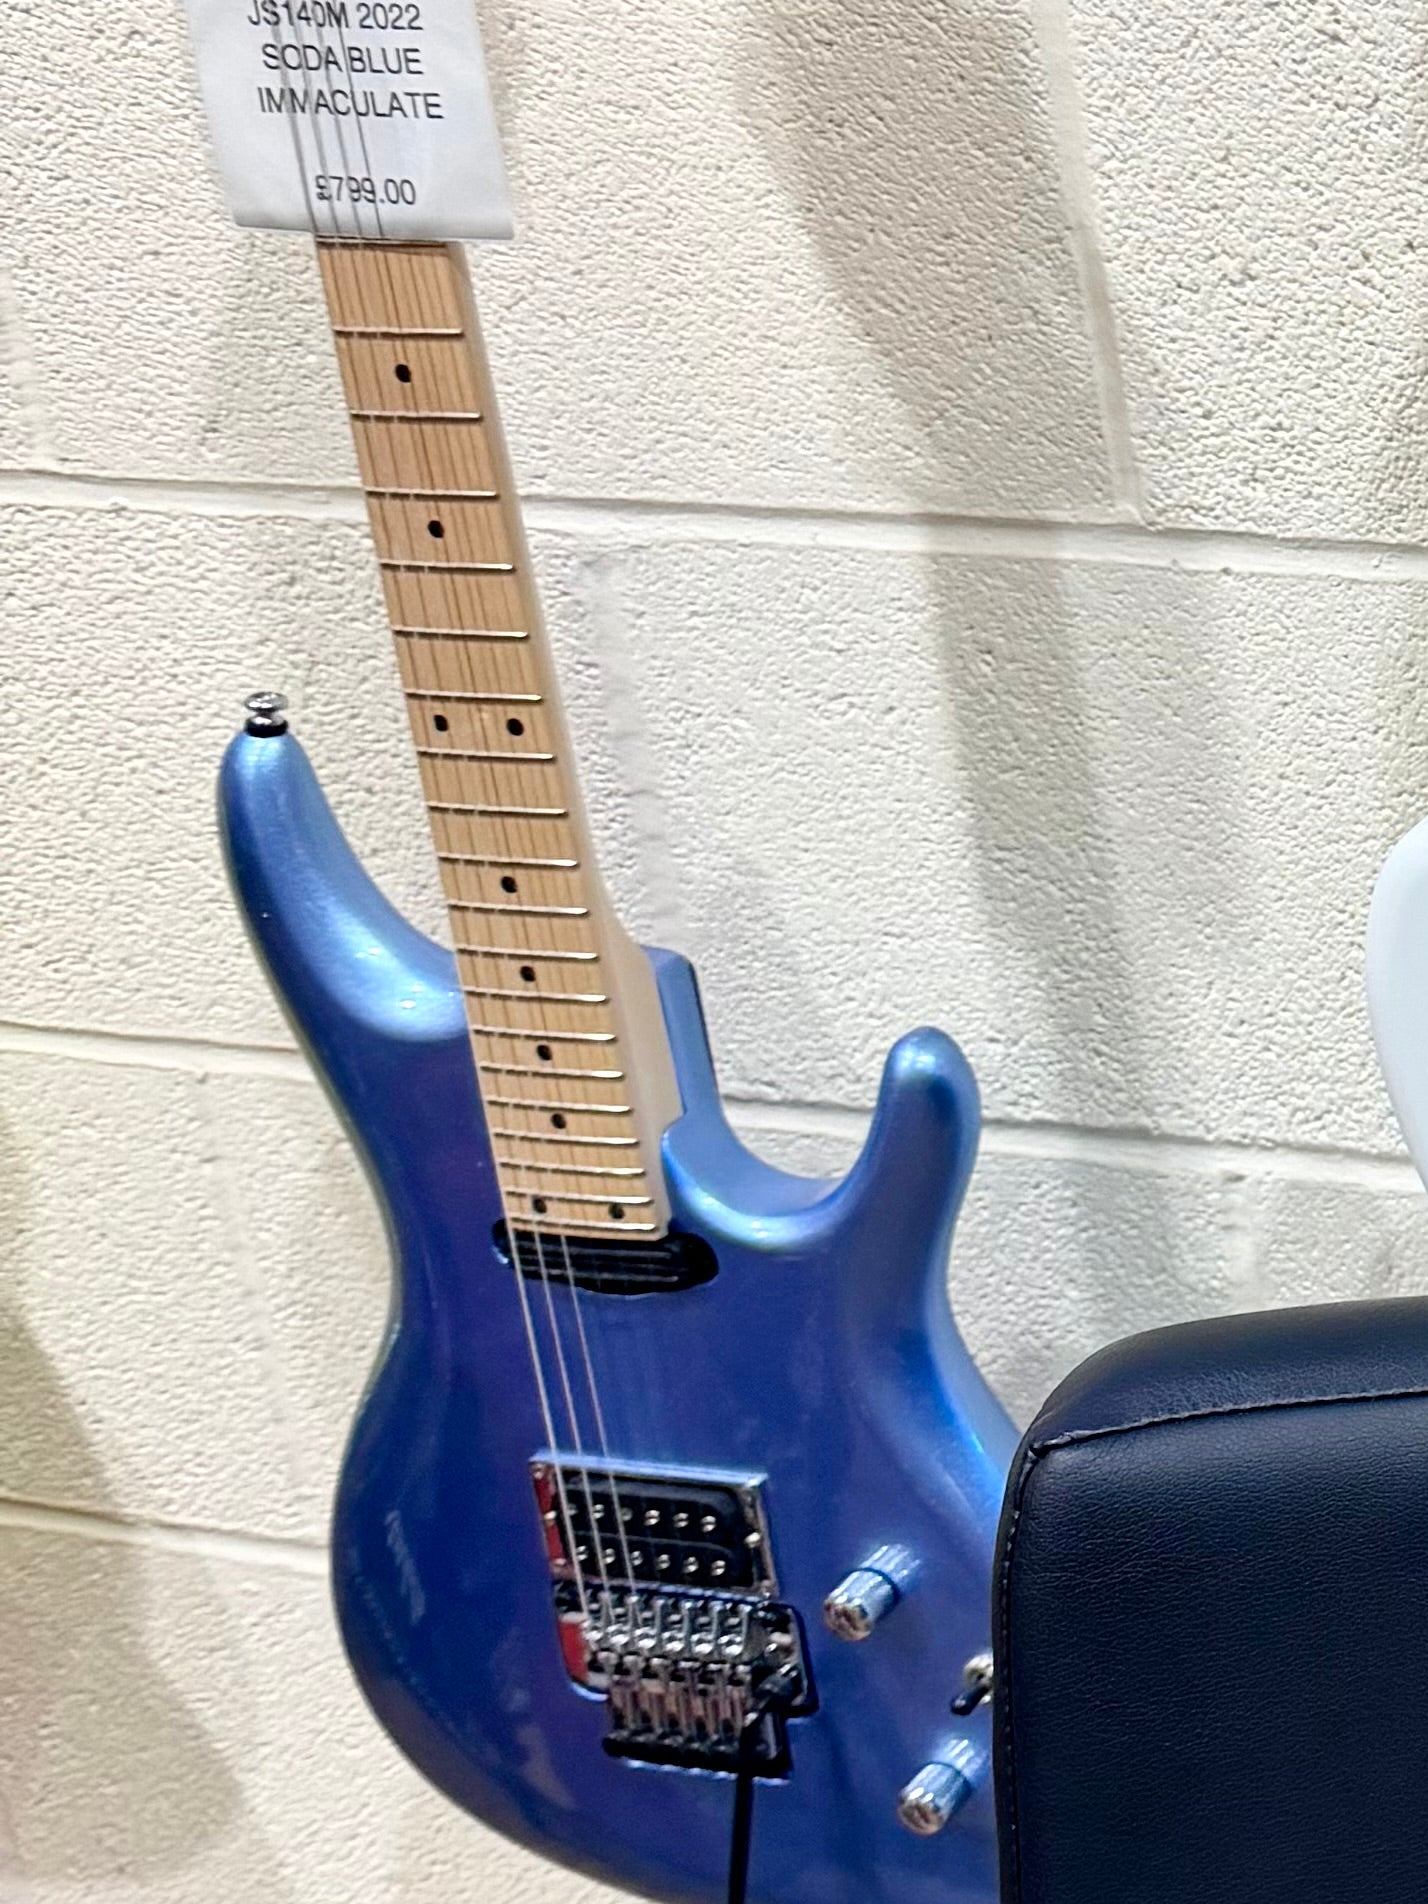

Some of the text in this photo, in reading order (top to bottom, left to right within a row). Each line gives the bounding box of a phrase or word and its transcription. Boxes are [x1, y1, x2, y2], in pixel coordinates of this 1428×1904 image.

[247, 0, 424, 31] JS140M 2022
[262, 43, 424, 75] SODA BLUE
[258, 86, 445, 120] IMMACULATE
[316, 174, 417, 207] £799.00
